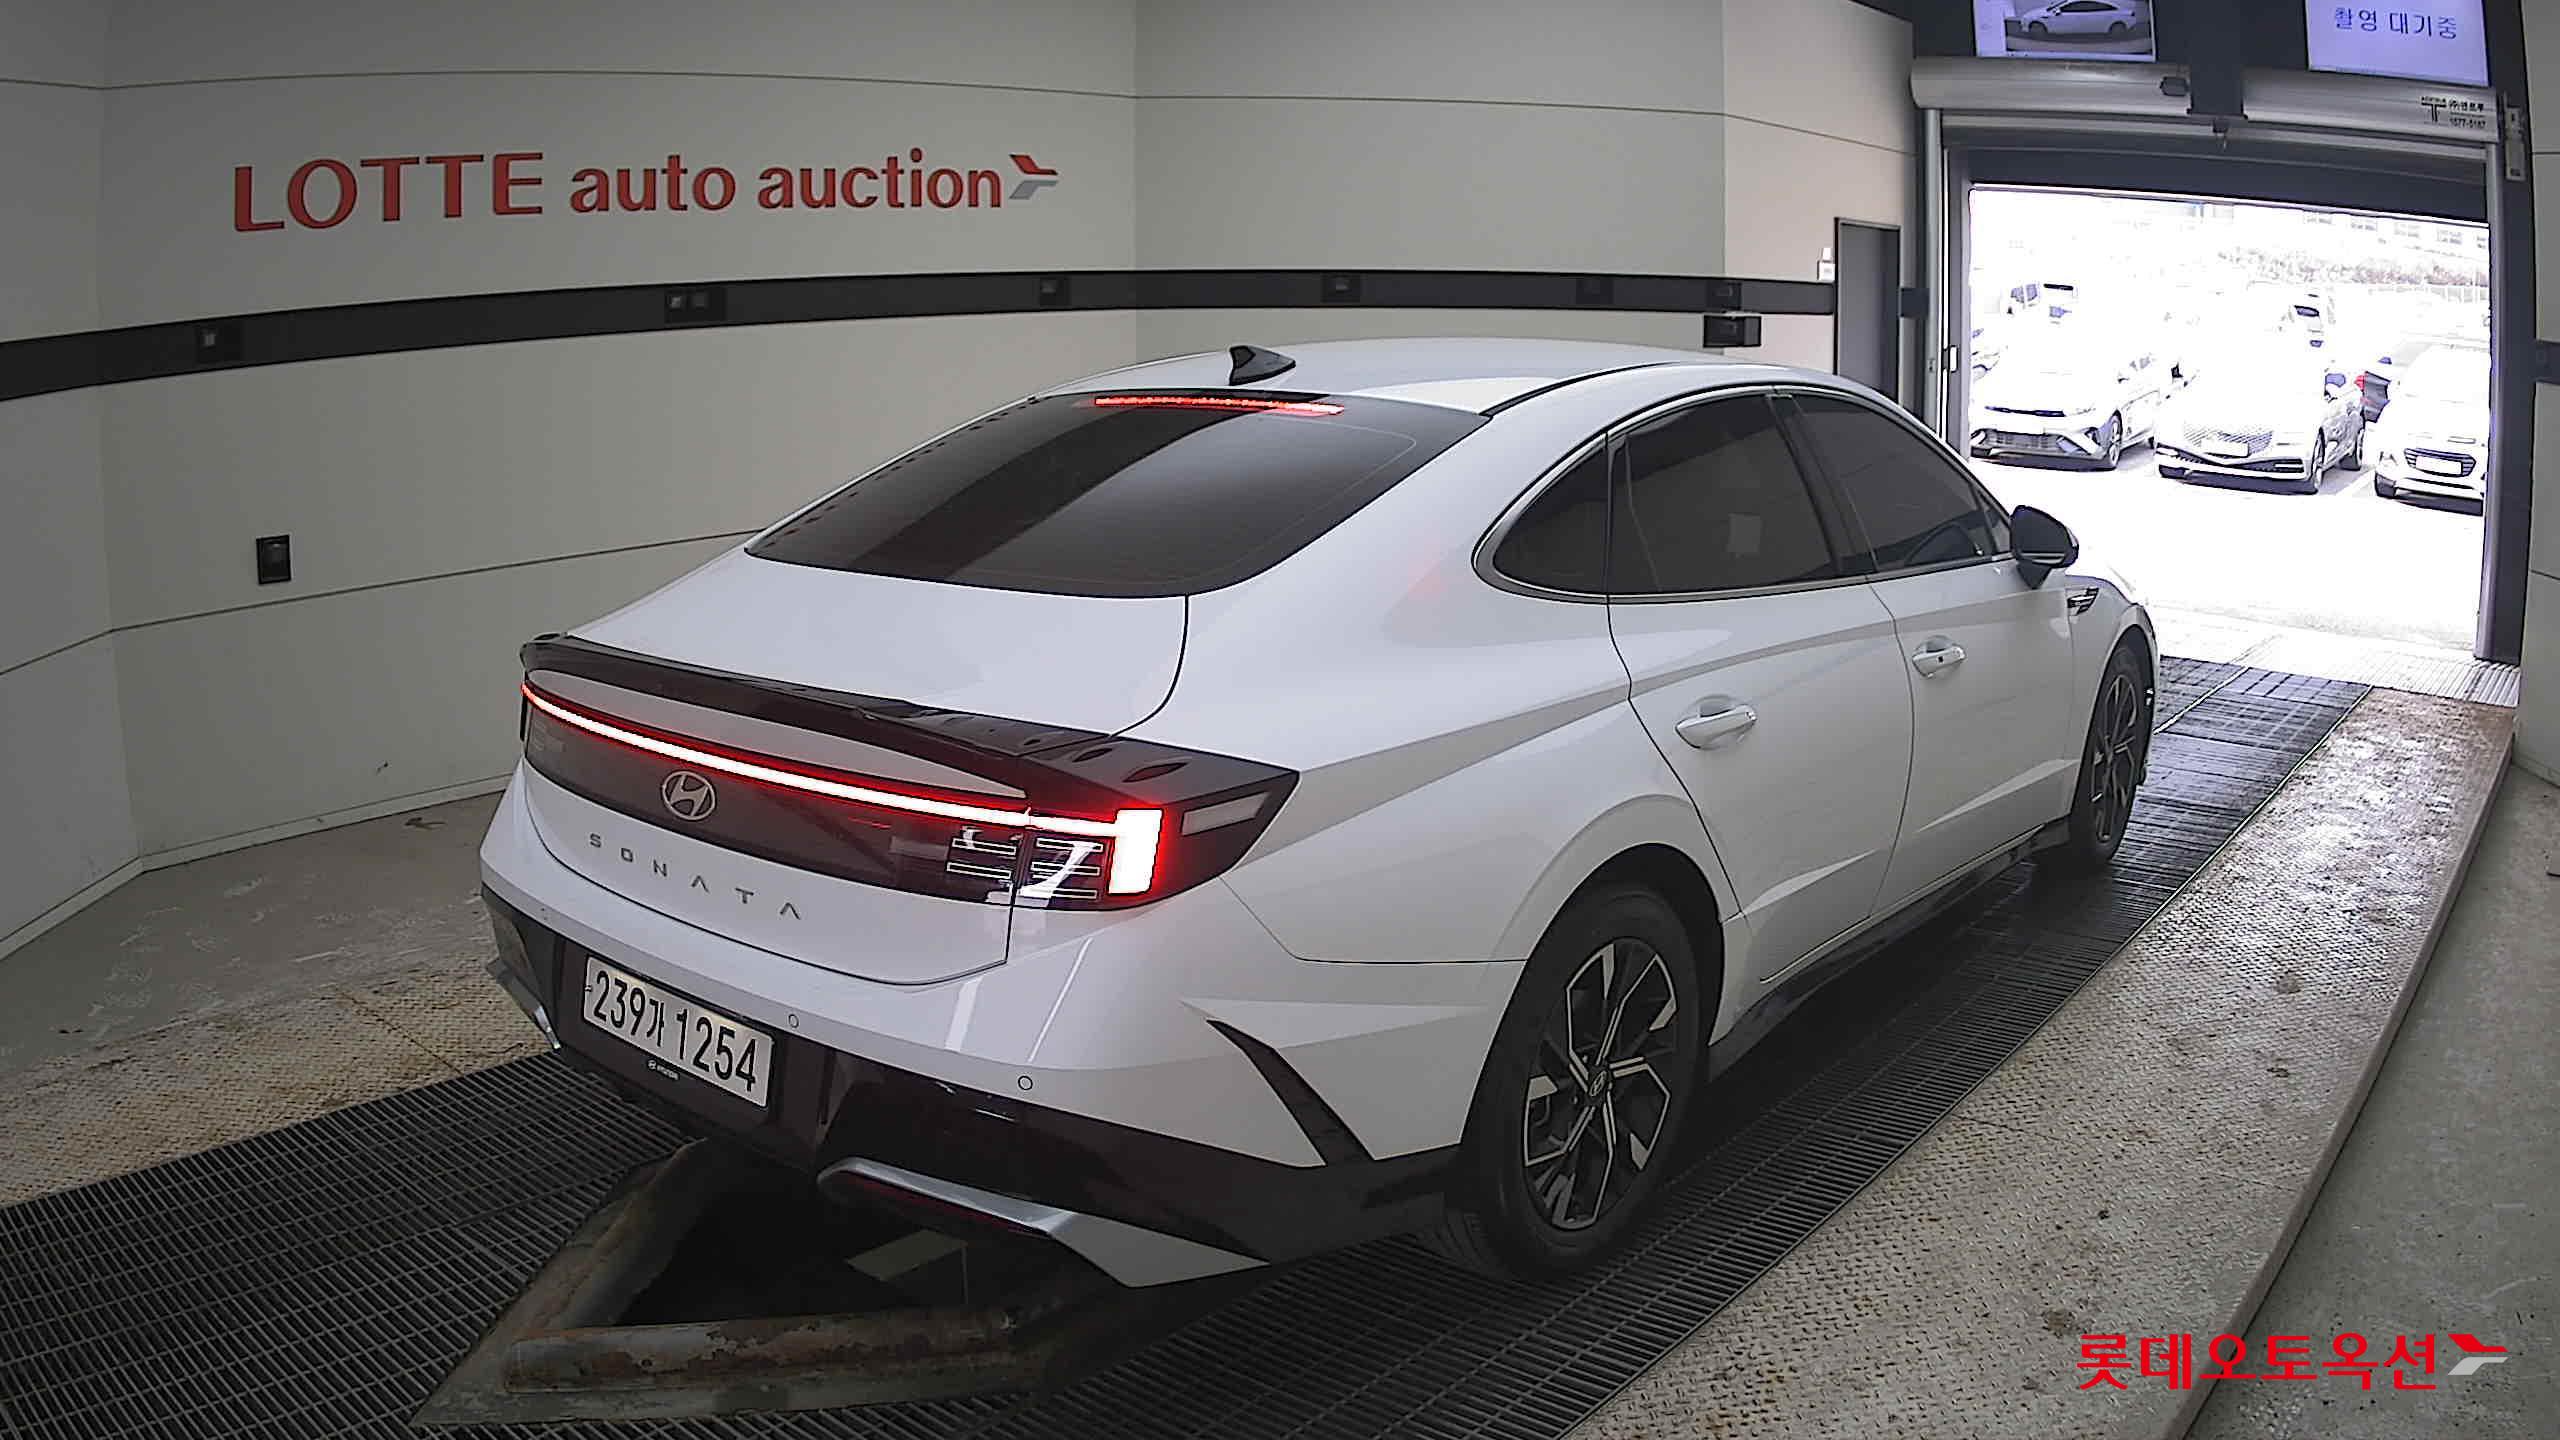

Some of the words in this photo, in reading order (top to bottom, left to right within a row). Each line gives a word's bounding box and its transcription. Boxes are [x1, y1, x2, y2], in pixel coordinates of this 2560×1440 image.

[2335, 7, 2377, 32] 촬영
[2389, 12, 2457, 39] 대기중
[235, 153, 543, 233] LOTTE
[570, 154, 737, 213] auto
[757, 147, 1003, 209] auction
[589, 832, 801, 921] SONATA
[593, 970, 665, 1048] 239가
[676, 1008, 758, 1092] 1254
